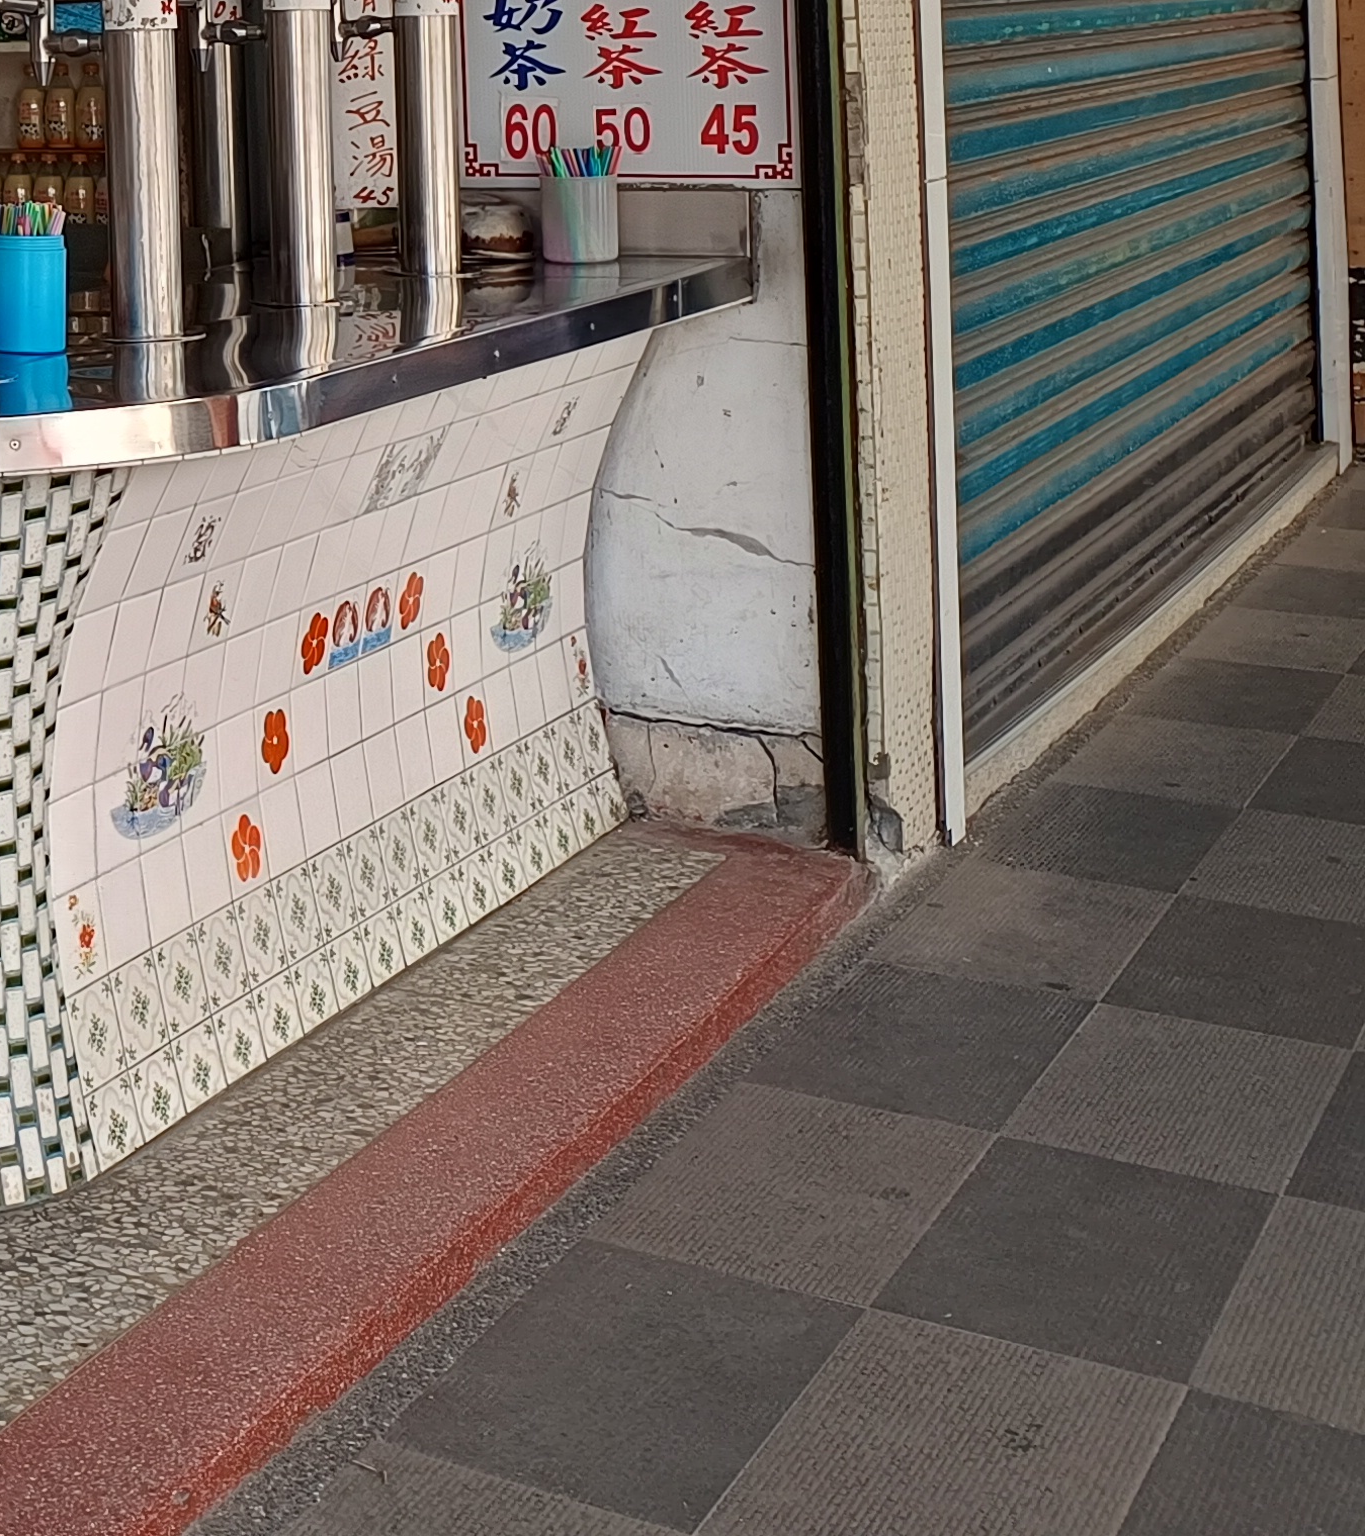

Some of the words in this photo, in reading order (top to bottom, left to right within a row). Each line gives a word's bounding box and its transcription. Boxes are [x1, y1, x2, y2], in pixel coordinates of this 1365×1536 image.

[337, 37, 394, 179] 綠豆湯
[505, 103, 557, 161] 60
[594, 107, 651, 154] 50
[700, 104, 760, 155] 45
[353, 186, 395, 206] 45
